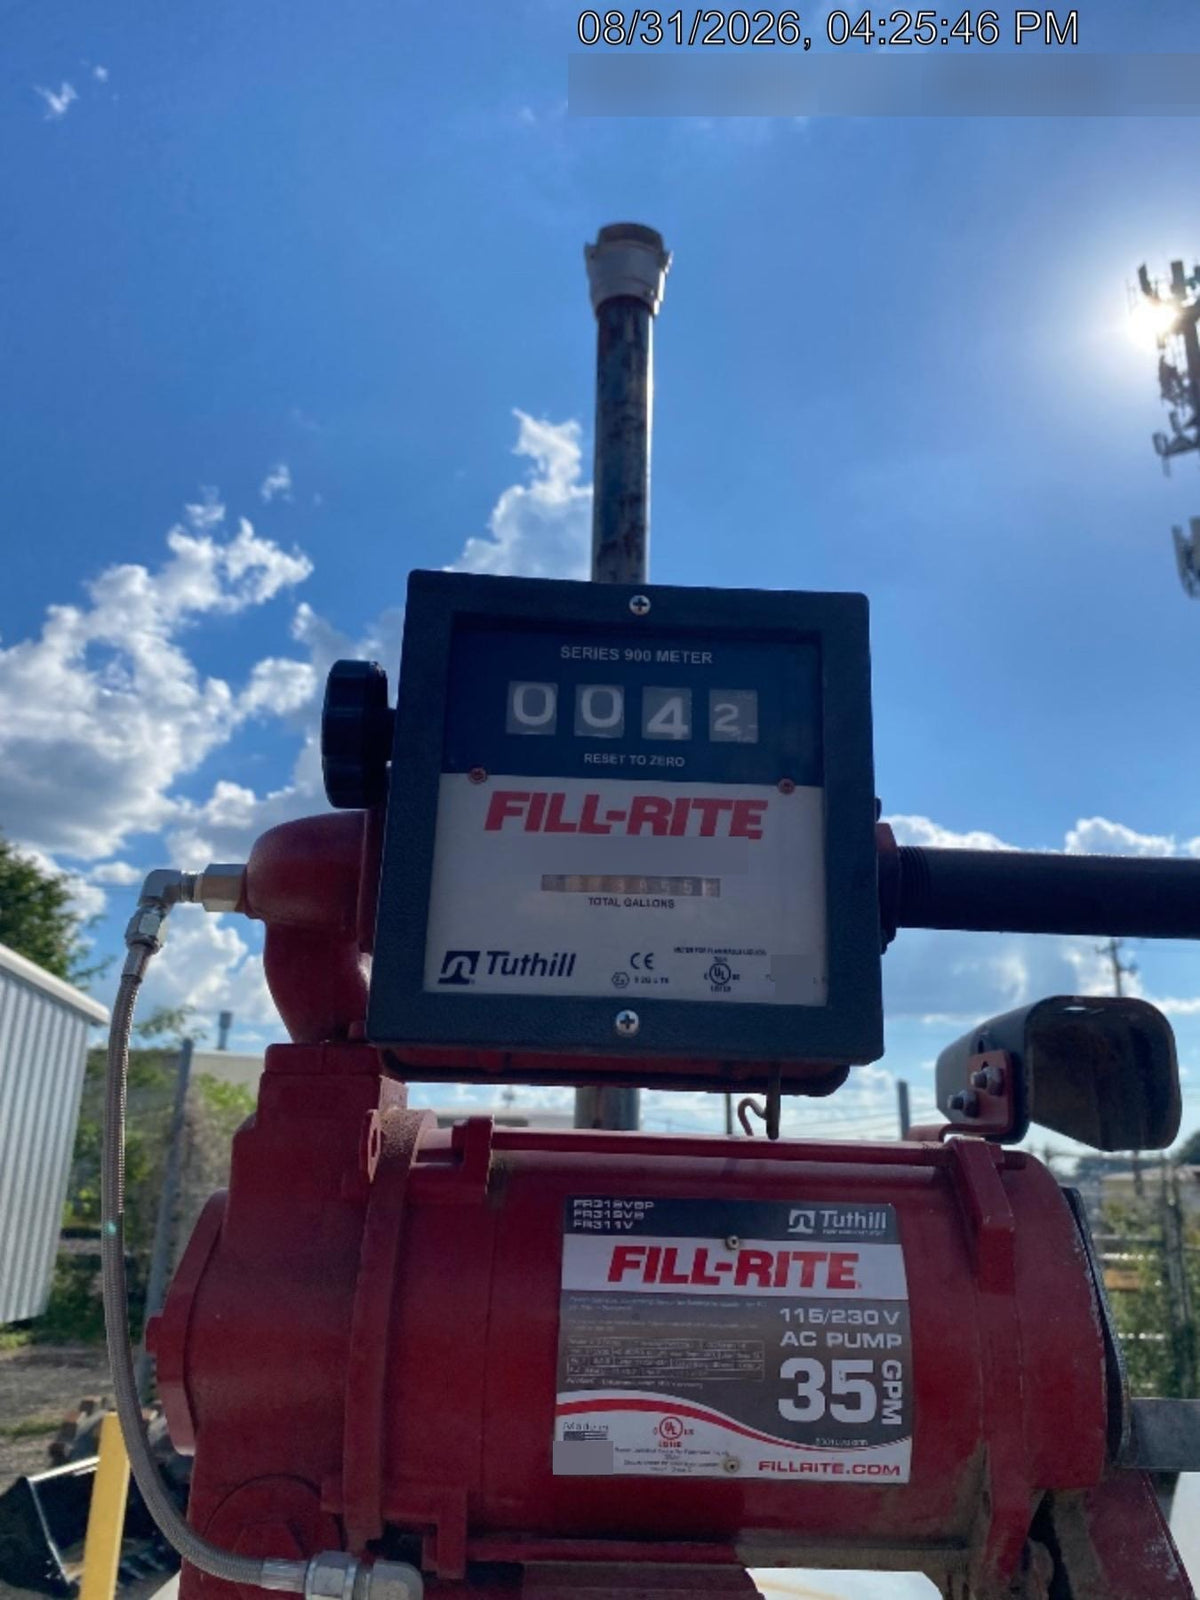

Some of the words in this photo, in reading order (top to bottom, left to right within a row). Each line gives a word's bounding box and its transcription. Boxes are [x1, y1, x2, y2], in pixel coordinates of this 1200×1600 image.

[560, 645, 620, 662] SERIES
[624, 648, 652, 663] 900
[656, 649, 713, 664] METER
[584, 752, 626, 766] RESET
[629, 754, 647, 767] TO
[649, 754, 686, 768] ZERO
[484, 790, 769, 840] FILL-RITE
[588, 896, 621, 908] TOTAL
[623, 897, 675, 909] GALLONS
[487, 950, 577, 977] Tuthill
[819, 1209, 887, 1229] Tuthill
[607, 1246, 860, 1289] FILL-RITE
[780, 1307, 879, 1325] 115/230
[882, 1311, 900, 1323] V
[780, 1331, 817, 1347] AC
[826, 1332, 902, 1348] PUMP
[778, 1356, 878, 1423] 35
[881, 1359, 903, 1425] GPM
